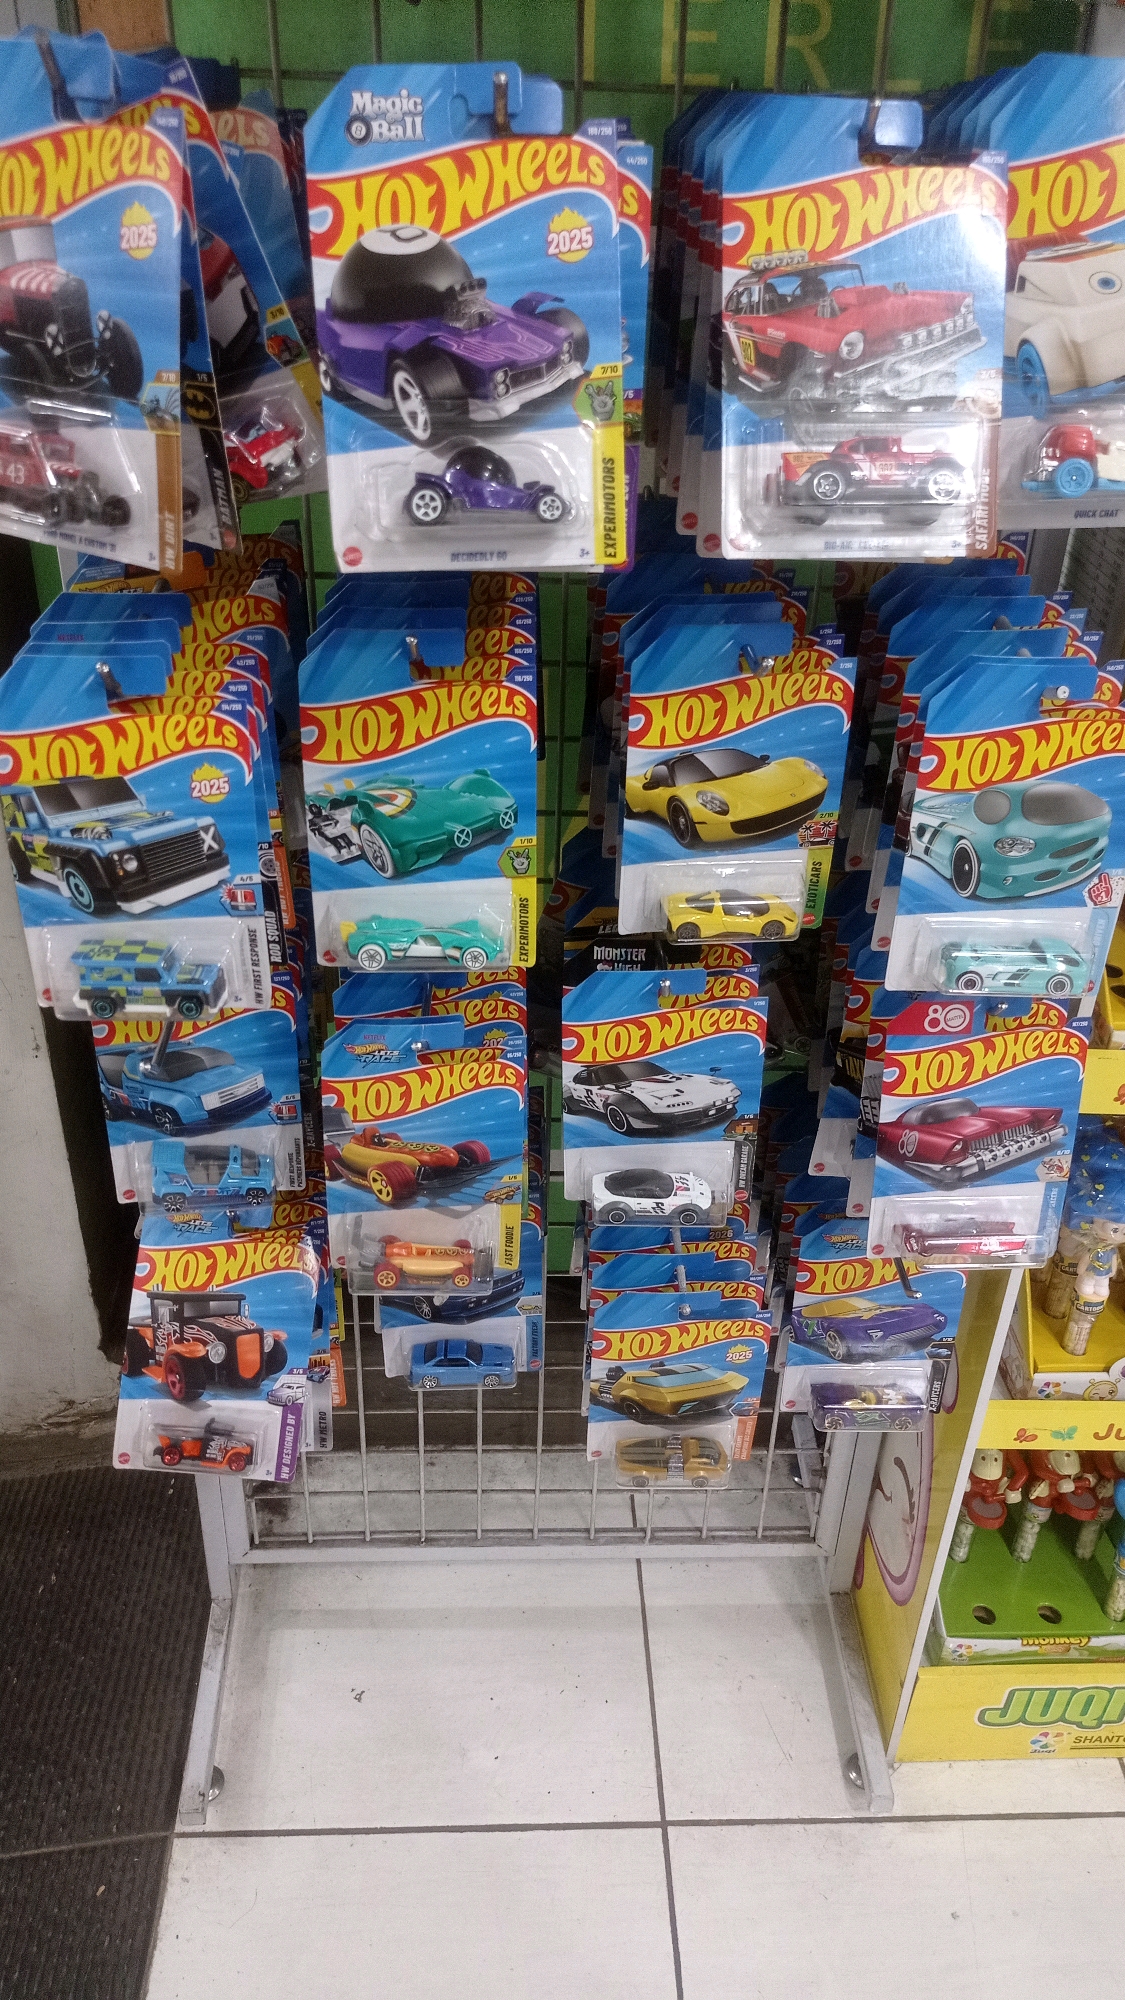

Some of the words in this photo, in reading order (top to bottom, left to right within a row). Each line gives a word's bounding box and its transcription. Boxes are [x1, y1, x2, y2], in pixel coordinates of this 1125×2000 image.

[351, 88, 424, 123] Magic
[372, 116, 425, 142] Ball
[0, 147, 40, 218] OT
[319, 173, 437, 256] HOT
[424, 140, 606, 236] WHEELS
[119, 222, 158, 252] 2025
[547, 226, 594, 256] 2025
[600, 364, 619, 375] 7/10
[5, 463, 26, 486] 43
[213, 466, 233, 527] BATMAN
[604, 457, 617, 559] EXPERIMOTORS
[163, 511, 175, 542] DIRT
[975, 504, 989, 551] SAFARI
[1073, 510, 1096, 519] QUICK
[1097, 509, 1121, 518] CHAT
[164, 545, 176, 570] HW
[306, 704, 398, 761] HOT
[388, 684, 527, 750] WHEELS
[636, 693, 724, 747] HOT
[716, 672, 844, 735] WHEELS
[10, 732, 98, 784] HOT
[86, 714, 238, 777] WHEELS
[926, 735, 1020, 790] HOT
[1013, 719, 1125, 780] WHEE
[190, 776, 230, 799] 2025
[819, 812, 834, 820] 2/10
[519, 838, 534, 846] 1/10
[806, 859, 822, 910] EXOTICARS
[265, 910, 279, 942] SQUAD
[518, 896, 530, 963] EXPERIMOTORS
[249, 929, 261, 968] RESPONSE
[271, 943, 282, 963] ROD
[593, 946, 647, 962] MONSTER
[254, 969, 263, 991] FIRST
[569, 1024, 648, 1063] HOT
[638, 1007, 759, 1054] WHEELS
[359, 1054, 402, 1064] RACE
[891, 1053, 972, 1095] HOT
[966, 1030, 1081, 1085] WHEELS
[327, 1080, 407, 1121] HOT
[398, 1061, 517, 1111] WHEELS
[505, 1225, 514, 1248] FOODIE
[144, 1248, 217, 1291] HOT
[208, 1243, 318, 1288] WHEELS
[504, 1248, 513, 1266] FAST
[810, 1260, 878, 1294] HOT
[531, 1336, 539, 1357] FACTORY
[606, 1331, 668, 1361] HOT
[662, 1319, 764, 1355] WHEELS
[725, 1350, 753, 1362] 2025
[929, 1380, 942, 1412] X-RAYCERS
[285, 1414, 296, 1425] BY
[319, 1411, 327, 1434] METRO
[282, 1426, 295, 1464] DESIGNED
[319, 1436, 328, 1449] HW
[280, 1465, 291, 1480] HW
